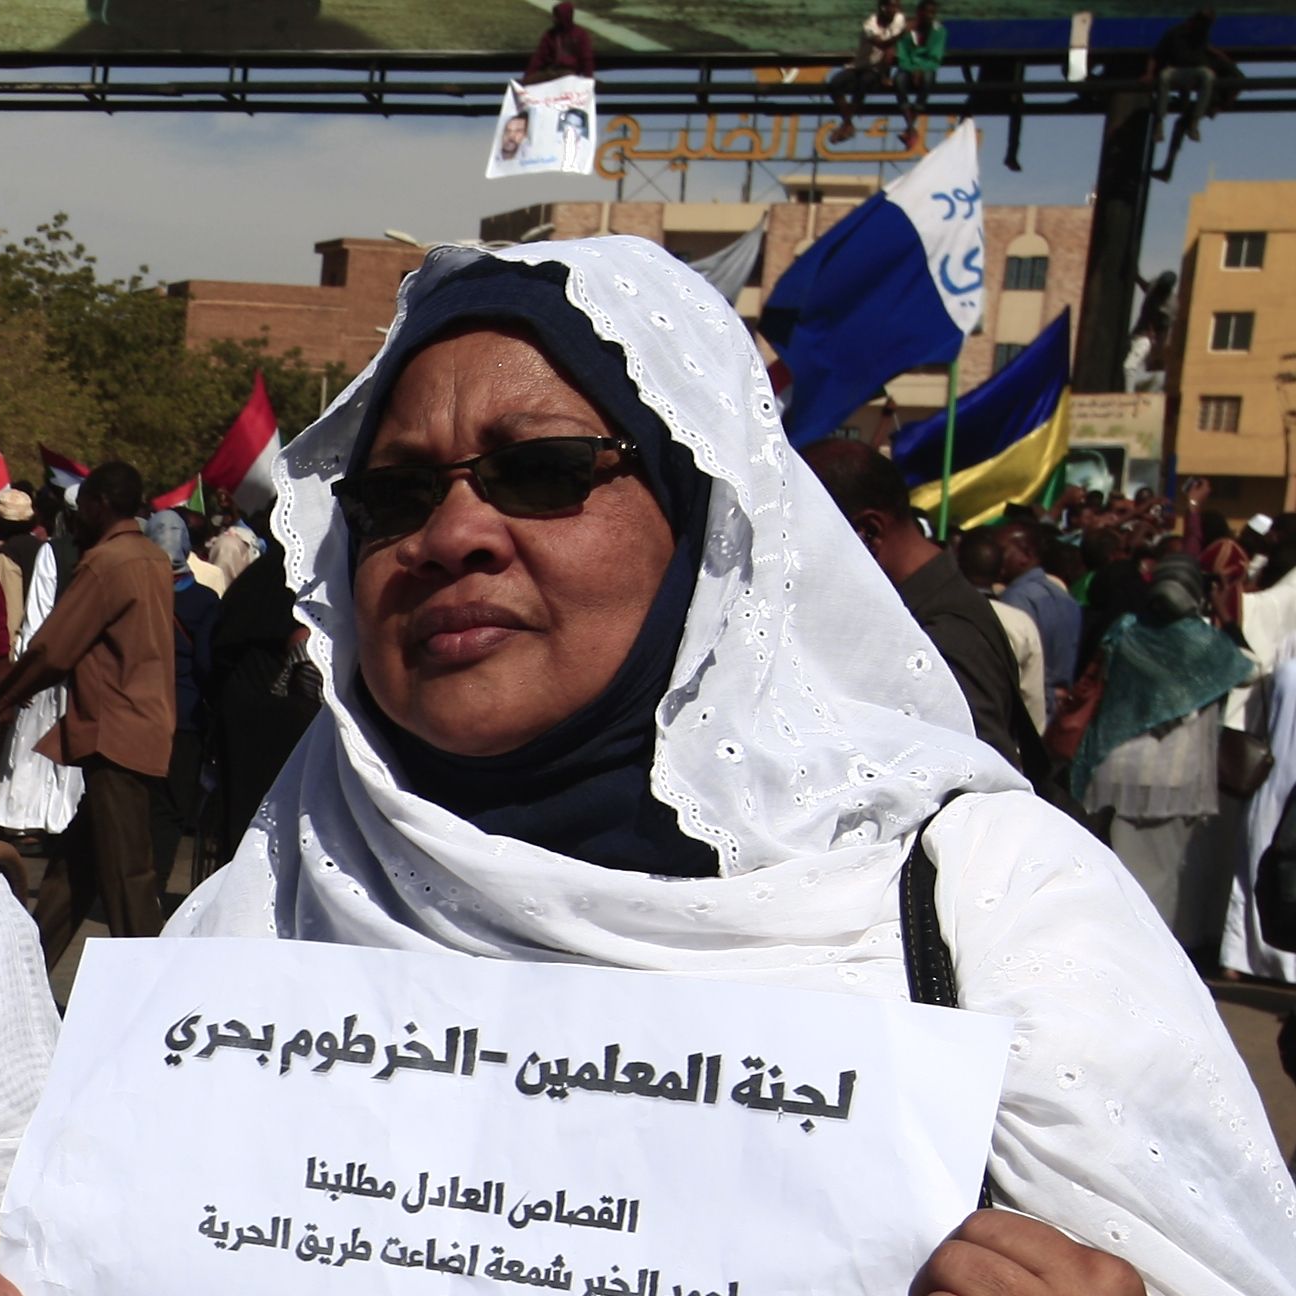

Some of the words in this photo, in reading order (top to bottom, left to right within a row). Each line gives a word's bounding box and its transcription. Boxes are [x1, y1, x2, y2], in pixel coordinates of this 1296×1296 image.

[595, 113, 800, 180] الخليج
[164, 1004, 275, 1067] بحري
[515, 1042, 721, 1105] المعلمين
[730, 1054, 857, 1132] لجنة
[305, 1156, 396, 1201] مطلبنا
[401, 1172, 505, 1216] العادل
[197, 1204, 292, 1252] الحرية
[507, 1189, 640, 1233] القصاص
[295, 1223, 373, 1267] طريق
[484, 1245, 573, 1291] شمعة
